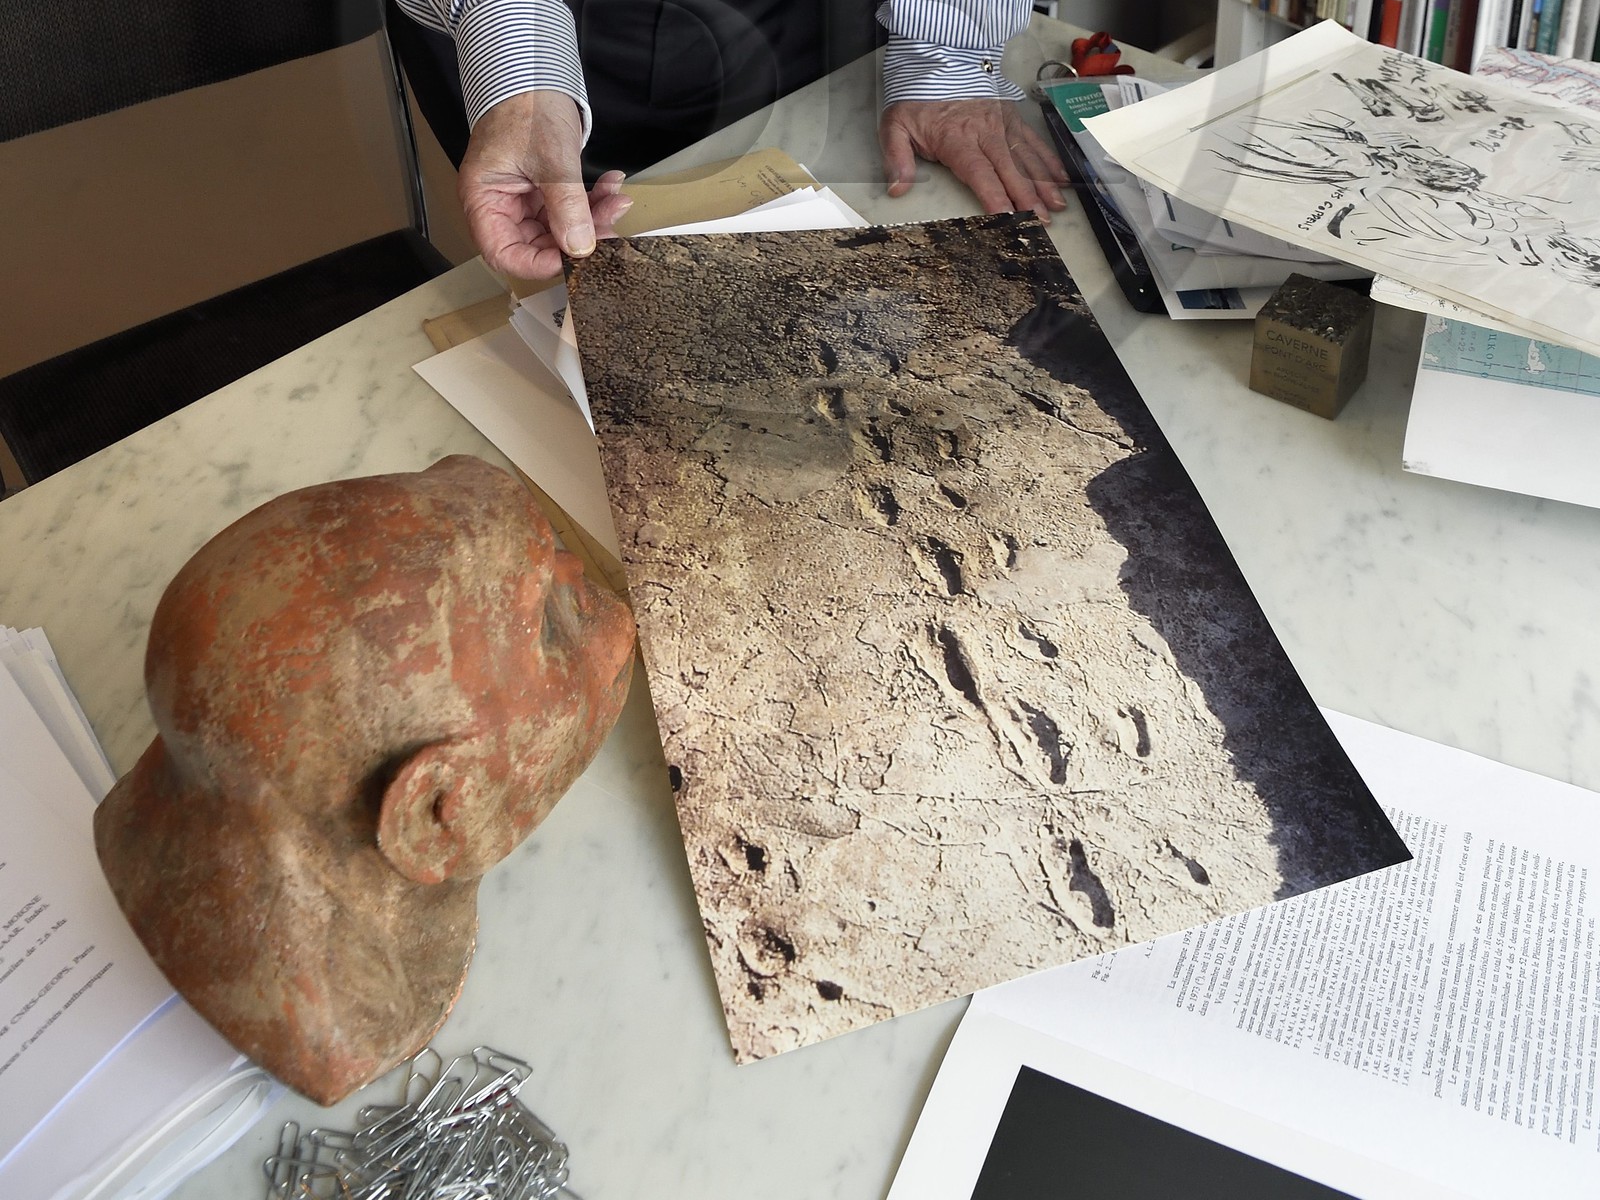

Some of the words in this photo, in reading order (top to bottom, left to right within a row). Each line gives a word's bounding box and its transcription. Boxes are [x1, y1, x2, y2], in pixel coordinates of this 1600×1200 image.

[1298, 201, 1333, 231] COPPENS
[1266, 330, 1329, 361] CAVERNE
[1264, 344, 1292, 360] PONT
[1295, 355, 1328, 373] D'ARC
[1486, 839, 1495, 854] deux
[1482, 855, 1493, 880] puisque
[1476, 881, 1488, 912] gisements
[2, 895, 42, 929] MOIGNE
[1221, 930, 1232, 945] dans
[1226, 922, 1234, 930] le
[26, 946, 36, 957] de
[1204, 952, 1212, 960] 13
[1208, 938, 1217, 952] sites
[1232, 937, 1243, 954] restes
[1422, 1049, 1434, 1076] L'étude
[1430, 1023, 1438, 1038] tous
[1434, 977, 1447, 1011] documents
[1441, 955, 1450, 967] fait
[1448, 904, 1459, 941] commencer
[1454, 888, 1462, 904] mais
[1458, 852, 1468, 872] d'ores
[1463, 832, 1473, 845] déjà
[1468, 936, 1479, 962] richesse
[1167, 980, 1177, 989] La
[1172, 947, 1188, 978] campagne
[1182, 930, 1193, 946] 1974
[1176, 963, 1195, 1008] extraordinaire
[1191, 930, 1206, 963] provenant
[1200, 961, 1209, 974] soit
[1214, 952, 1226, 966] DD,
[1228, 955, 1237, 966] des
[1453, 942, 1466, 986] remarquables.
[10, 966, 73, 1024] CNRS-GEOPS,
[72, 945, 96, 964] Paris
[1208, 966, 1220, 992] membre
[1222, 967, 1233, 980] liste
[1189, 986, 1200, 1002] 1973
[1204, 992, 1212, 1000] le
[1214, 987, 1226, 1004] Voici
[1448, 986, 1458, 1001] faits
[1459, 963, 1475, 1012] l'extraordinaire
[1187, 1003, 1195, 1012] de
[1199, 1000, 1210, 1016] dans
[1445, 1001, 1456, 1030] quelques
[1457, 1014, 1467, 1043] concerne
[1439, 1030, 1452, 1056] dégager
[1452, 1044, 1462, 1073] premier
[1434, 1067, 1445, 1099] possible
